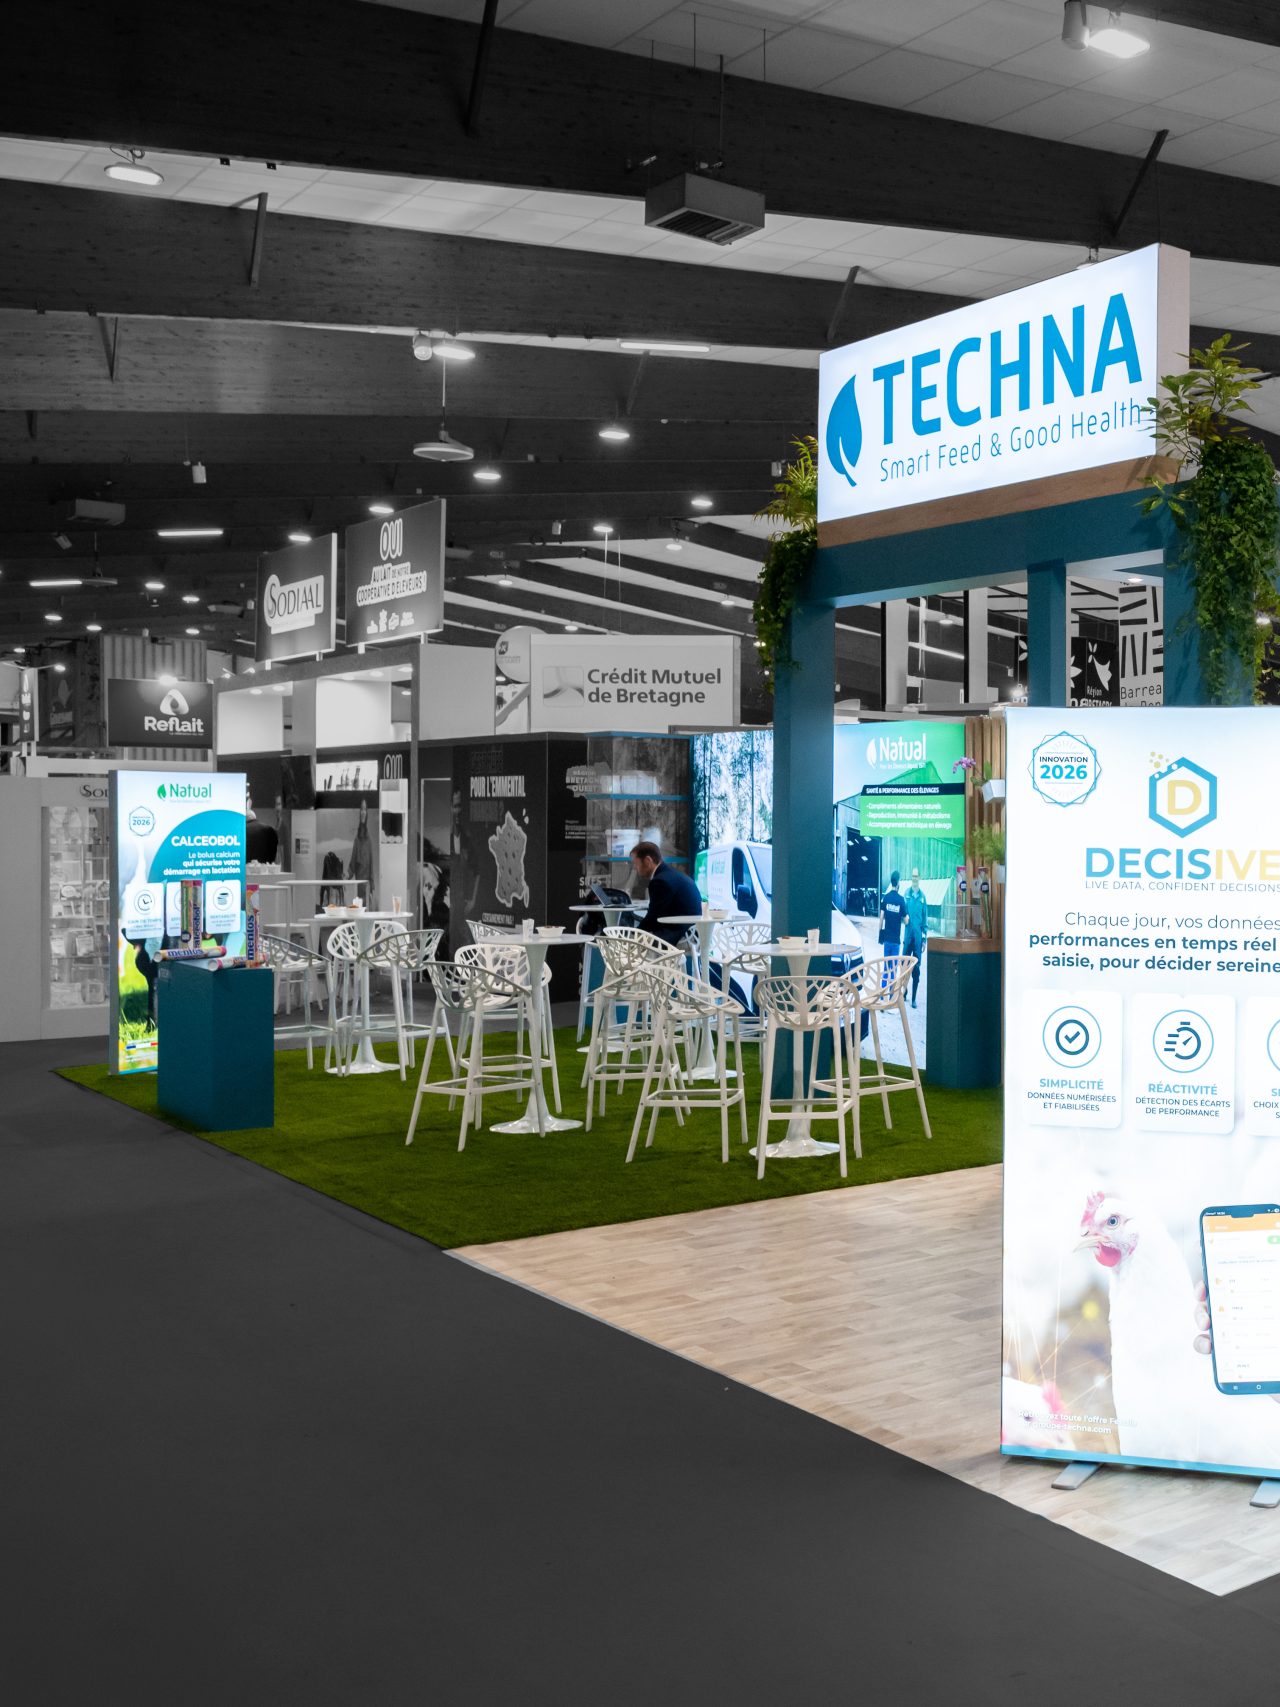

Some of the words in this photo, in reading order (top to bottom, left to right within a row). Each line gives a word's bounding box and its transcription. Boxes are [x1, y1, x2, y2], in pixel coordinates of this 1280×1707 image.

[872, 292, 1143, 446] TECHNA
[880, 447, 930, 482] Smart
[938, 434, 981, 469] Feed
[990, 432, 1002, 457] &
[1010, 415, 1061, 453] Good
[1071, 398, 1141, 439] Health
[380, 518, 403, 561] OUI
[587, 668, 647, 685] Crédit
[652, 668, 721, 685] Mutuel
[588, 688, 612, 704] de
[617, 688, 706, 707] Bretagne
[144, 716, 204, 733] Reflait
[880, 733, 926, 762] Natual
[1039, 756, 1088, 764] INNOVATION
[1040, 765, 1088, 780] 2026
[170, 783, 212, 798] Natual
[470, 776, 486, 797] POUR
[919, 786, 939, 794] ÉLEVAGES
[1167, 779, 1202, 815] D
[171, 835, 241, 847] CALCEOBOL
[183, 860, 194, 868] qui
[195, 859, 223, 867] sécurise
[163, 868, 201, 877] démarrage
[211, 866, 241, 874] lactation
[1085, 880, 1109, 890] LIVE
[1113, 881, 1145, 892] DATA,
[1148, 882, 1215, 892] CONFIDENT
[1065, 912, 1130, 930] Chaque
[1132, 913, 1170, 930] jour,
[1175, 916, 1204, 929] vos
[246, 915, 254, 961] mentos
[1029, 932, 1150, 950] performances
[1154, 937, 1176, 949] en
[1182, 935, 1238, 953] temps
[1243, 936, 1277, 952] réel
[167, 948, 203, 958] mentos
[1042, 953, 1094, 971] saisie,
[1099, 957, 1140, 972] pour
[1145, 955, 1212, 971] décider
[1039, 1077, 1104, 1091] SIMPLICITÉ
[1148, 1081, 1218, 1096] RÉACTIVITÉ
[1027, 1091, 1065, 1101] DONNÉES
[1067, 1092, 1116, 1103] NUMÉRISÉES
[1135, 1095, 1179, 1106] DÉTECTION
[1182, 1099, 1198, 1107] DES
[1200, 1098, 1231, 1108] ÉCARTS
[1043, 1102, 1052, 1110] ET
[1054, 1101, 1100, 1112] FIABILISÉES
[1145, 1107, 1156, 1115] DE
[1158, 1108, 1220, 1118] PERFORMANCE
[1253, 1101, 1279, 1110] CHOIX
[1060, 1414, 1081, 1422] toute
[1084, 1415, 1107, 1424] l'offre
